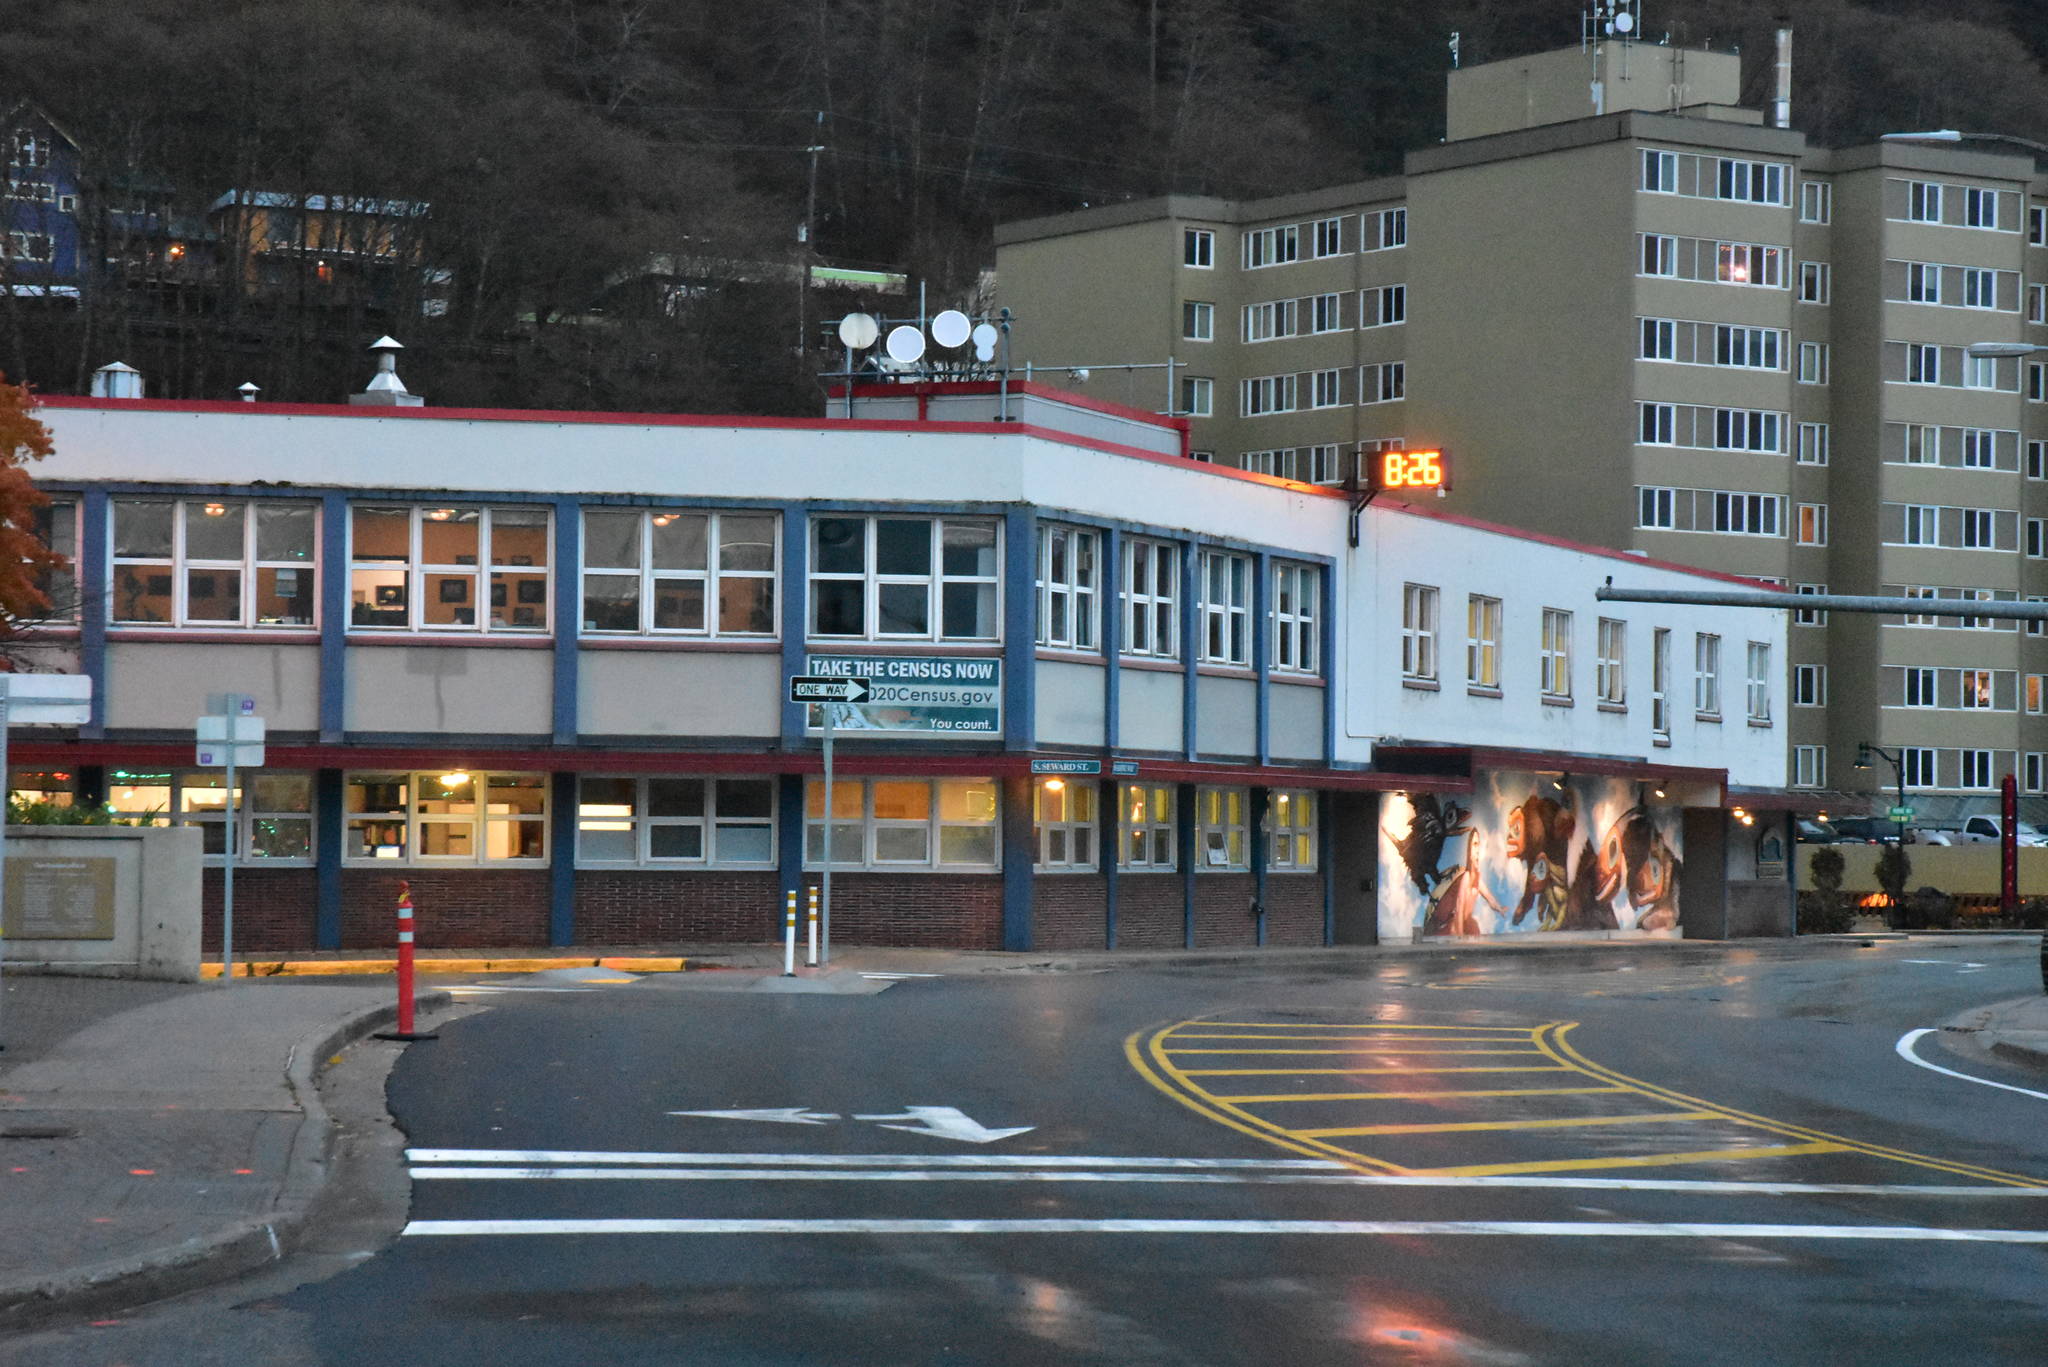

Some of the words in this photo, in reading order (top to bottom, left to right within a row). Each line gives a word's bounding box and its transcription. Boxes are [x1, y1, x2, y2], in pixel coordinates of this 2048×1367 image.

[1385, 452, 1441, 486] 8:26
[812, 660, 852, 676] TAKE
[854, 661, 884, 677] THE
[888, 662, 952, 678] CENSUS
[956, 663, 993, 679] NOW
[799, 684, 820, 695] ONE
[826, 685, 848, 695] WAY
[870, 687, 993, 706] 020Census.gov
[930, 718, 952, 729] You
[955, 720, 992, 730] count.
[1041, 762, 1076, 771] SEWARD
